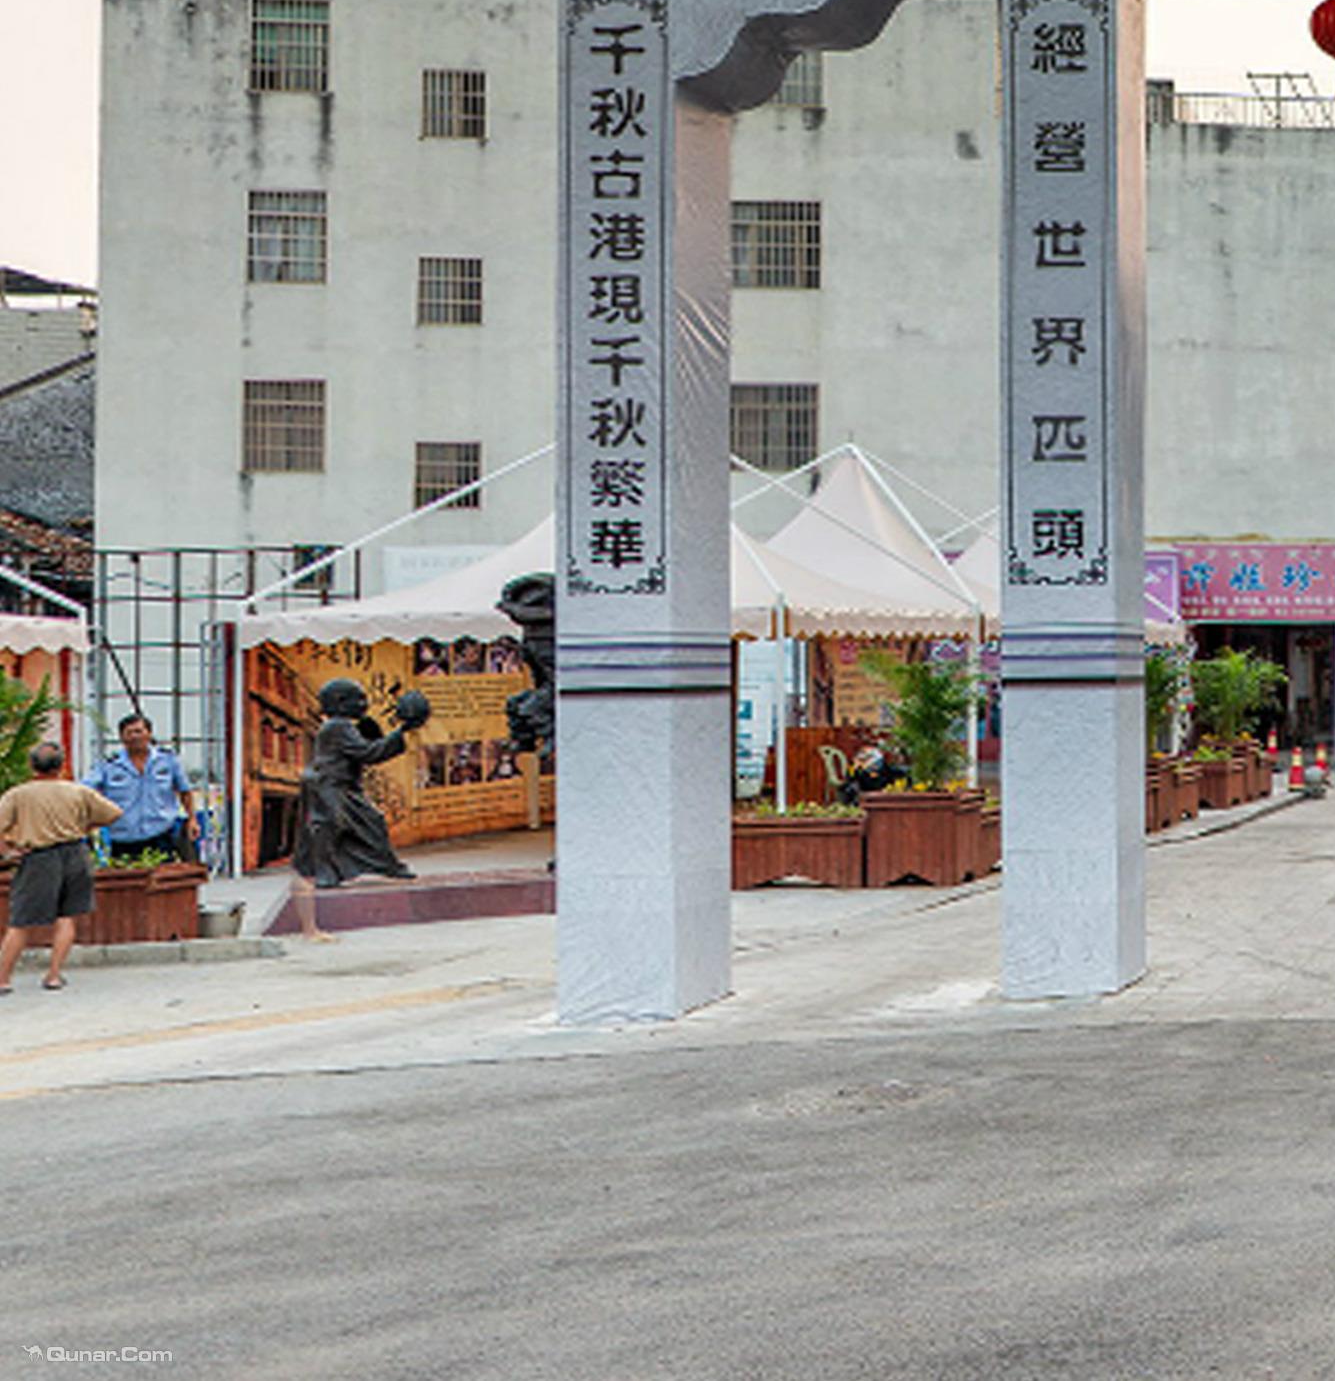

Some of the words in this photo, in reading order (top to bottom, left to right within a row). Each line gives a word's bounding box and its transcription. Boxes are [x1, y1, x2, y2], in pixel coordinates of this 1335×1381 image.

[588, 24, 647, 569] 千秋古港現千秋繁華
[1031, 21, 1088, 559] 經營世界匹頭
